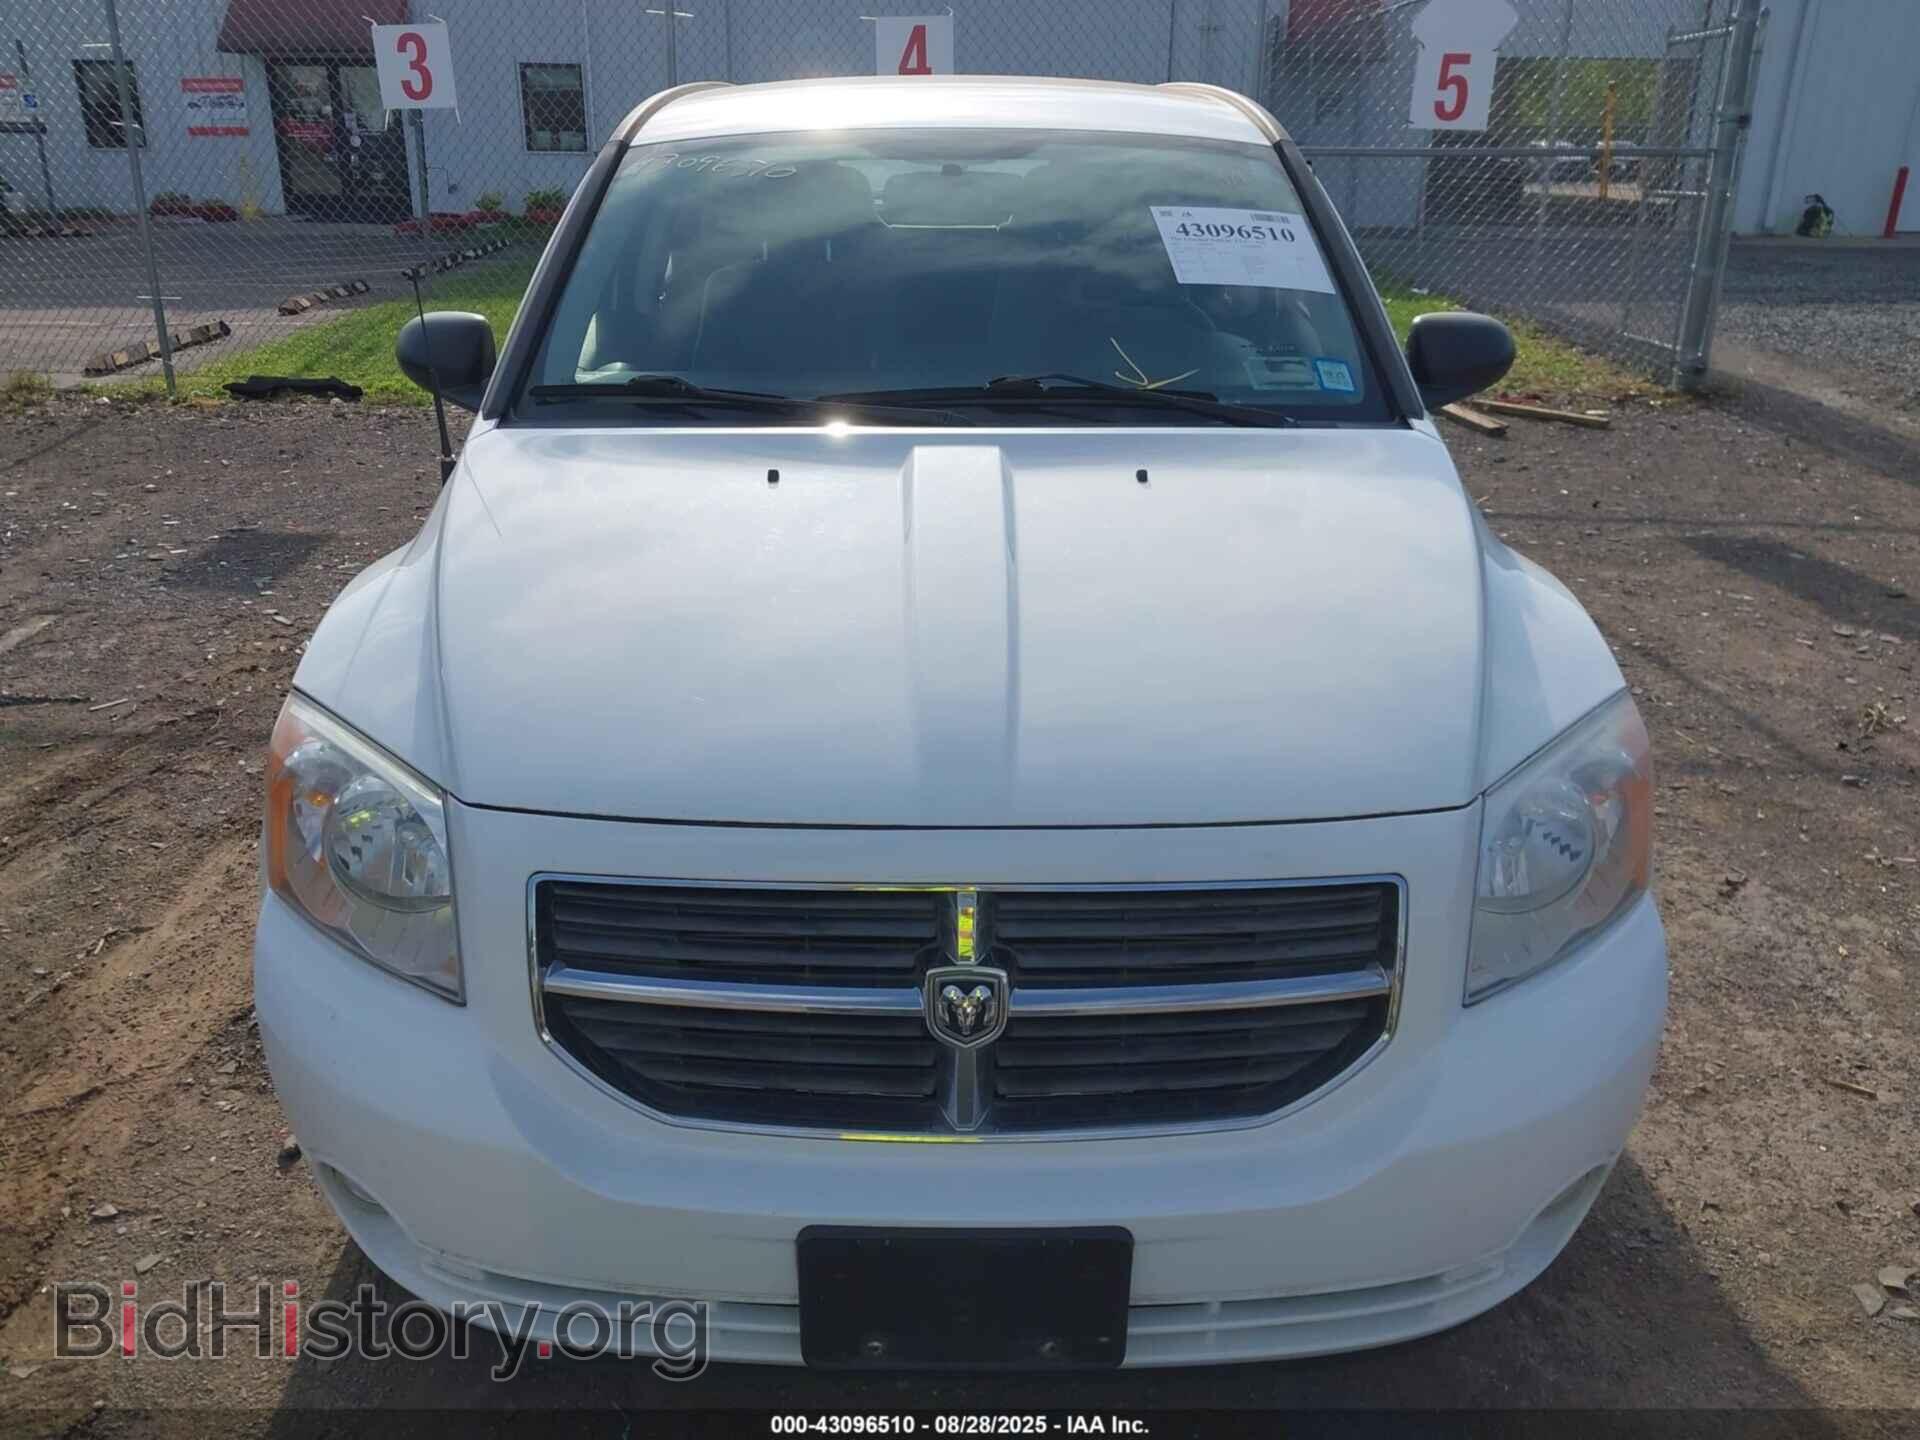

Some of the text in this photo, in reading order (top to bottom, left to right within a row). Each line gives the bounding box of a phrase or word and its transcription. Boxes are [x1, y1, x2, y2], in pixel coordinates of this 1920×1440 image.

[395, 32, 433, 101] 3
[898, 24, 933, 76] 4
[1433, 52, 1472, 122] 5
[1175, 222, 1296, 243] 43096510
